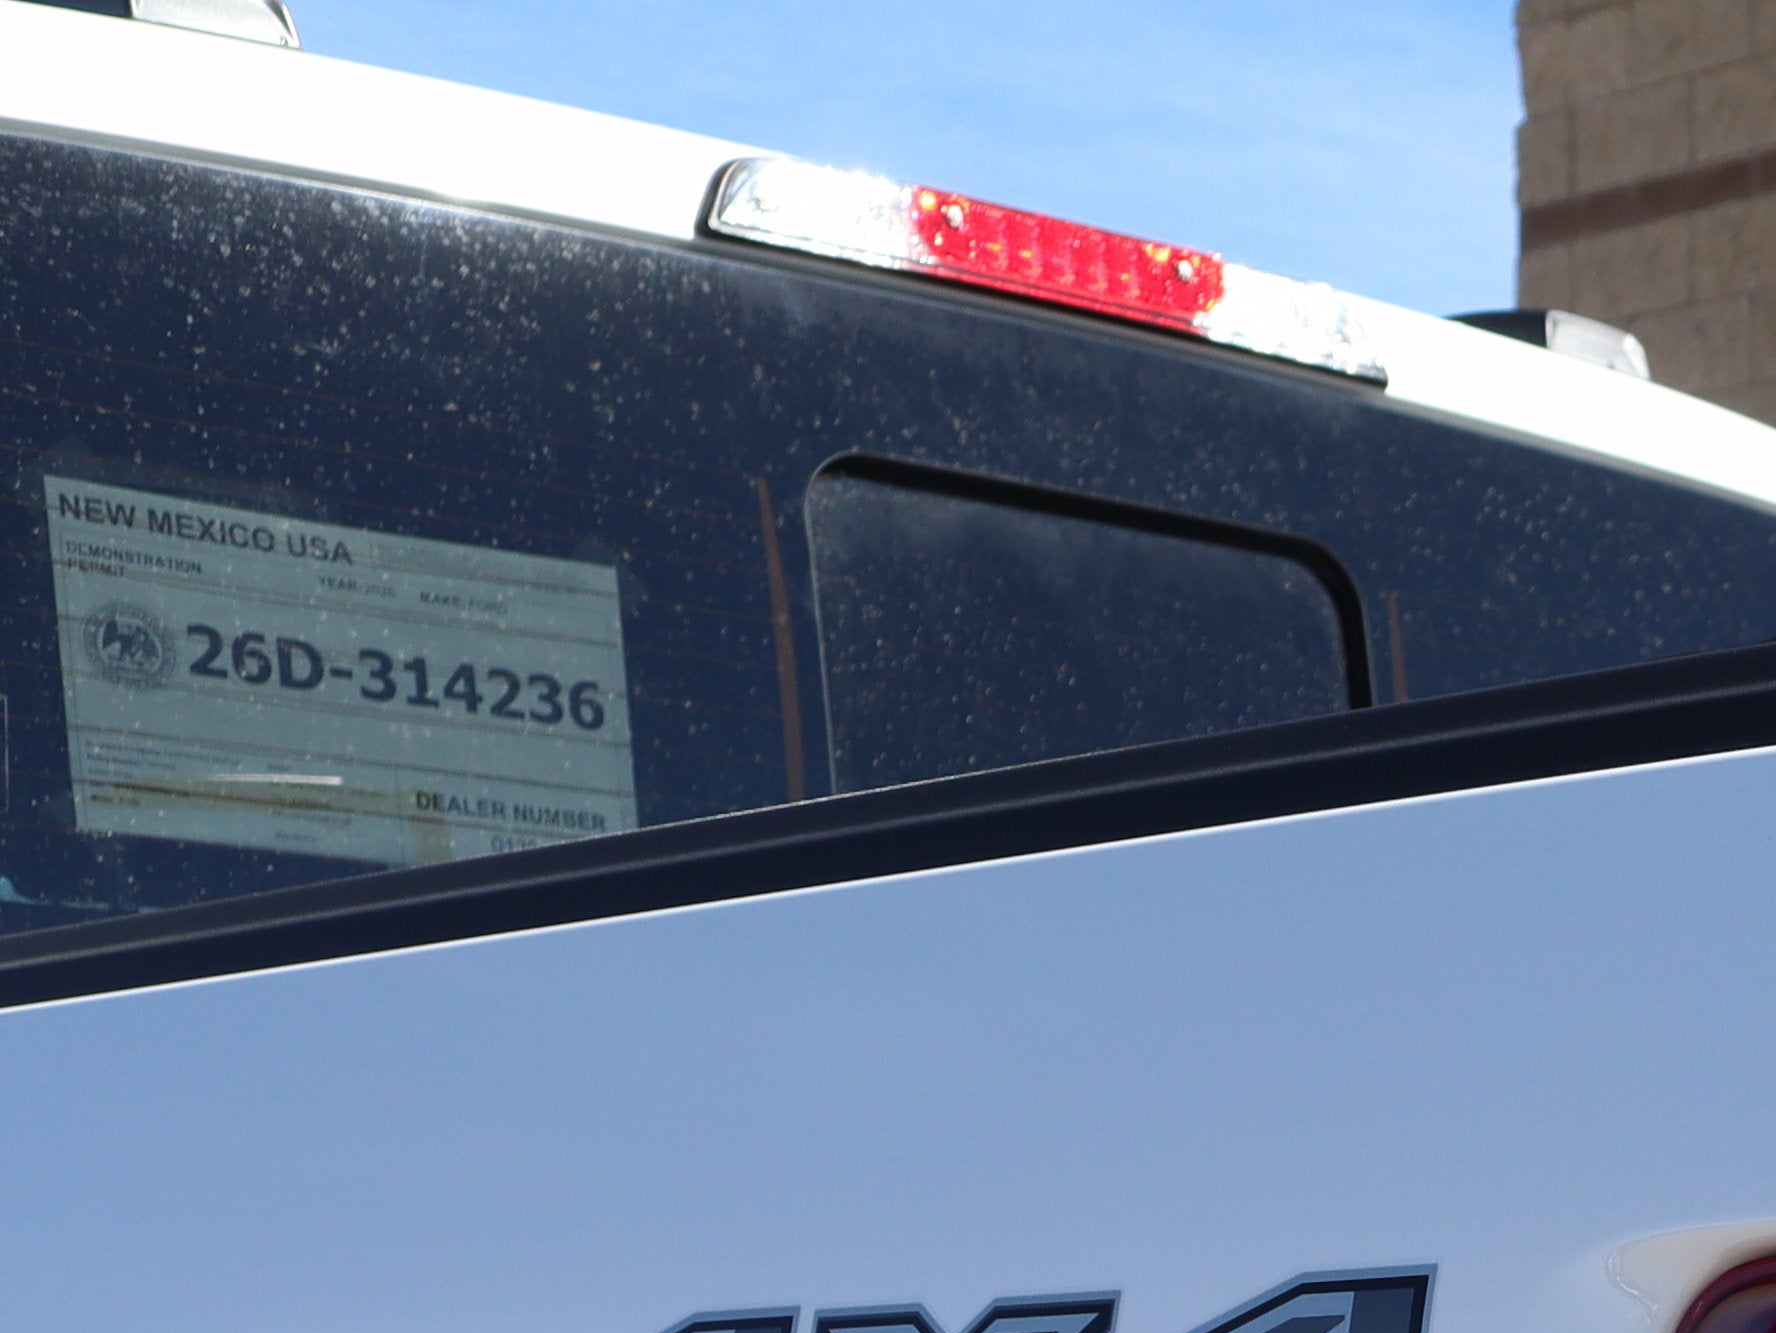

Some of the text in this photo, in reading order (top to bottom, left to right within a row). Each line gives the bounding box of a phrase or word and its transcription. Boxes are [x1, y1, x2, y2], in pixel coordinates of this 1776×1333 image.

[58, 492, 353, 564] NEW MEXICO USA
[66, 540, 202, 574] DEMONSTRATION
[185, 622, 606, 732] 26D-314236
[416, 789, 506, 820] DEALER
[513, 803, 606, 831] NUMBER
